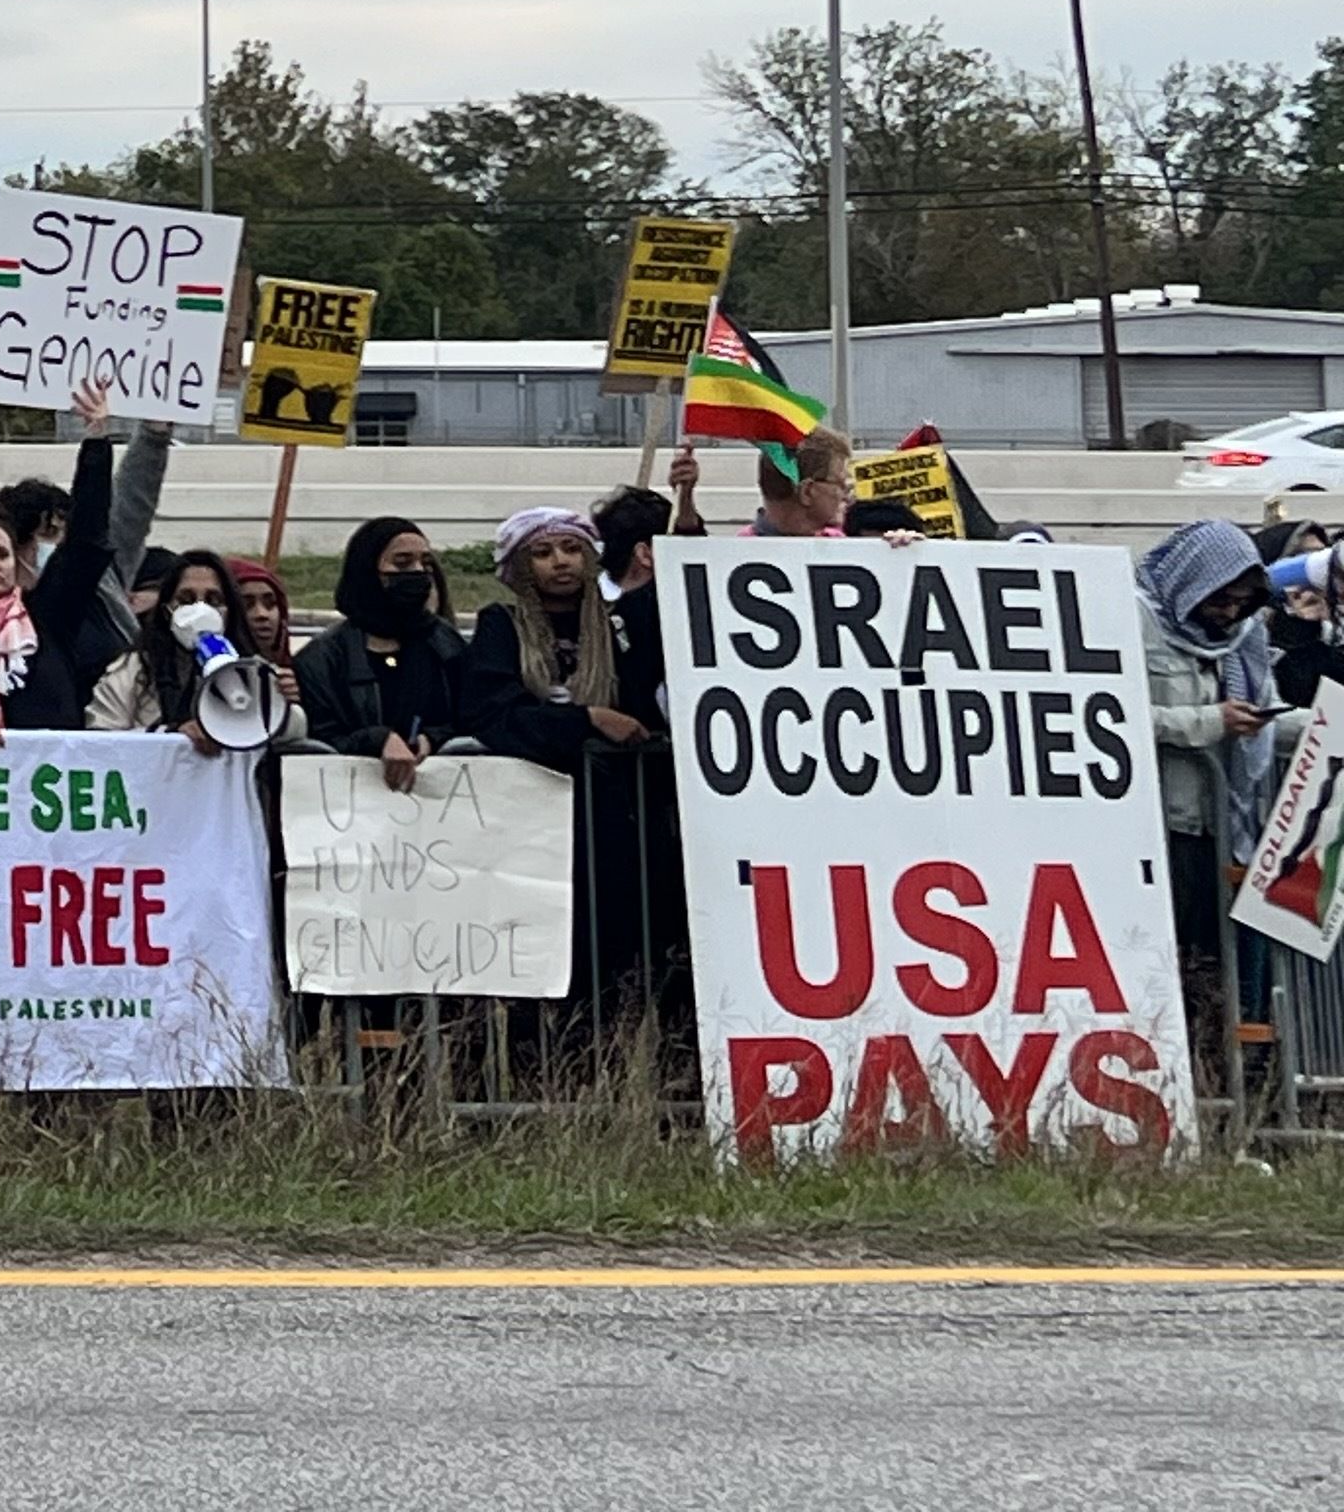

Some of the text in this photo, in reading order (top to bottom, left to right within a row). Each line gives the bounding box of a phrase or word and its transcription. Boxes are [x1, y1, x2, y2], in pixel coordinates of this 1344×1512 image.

[20, 211, 203, 287] STOP
[259, 324, 362, 355] PALESTINE
[269, 285, 362, 334] FREE
[681, 562, 1123, 675] ISRAEL
[693, 685, 1134, 801] OCCUPIES
[30, 763, 148, 836] SEA,
[1250, 706, 1329, 893] SOLIDARITY
[10, 865, 171, 968] FREE
[296, 917, 534, 986] GENOCIDE
[750, 859, 1130, 1021] USA
[726, 1030, 1172, 1170] PAYS
